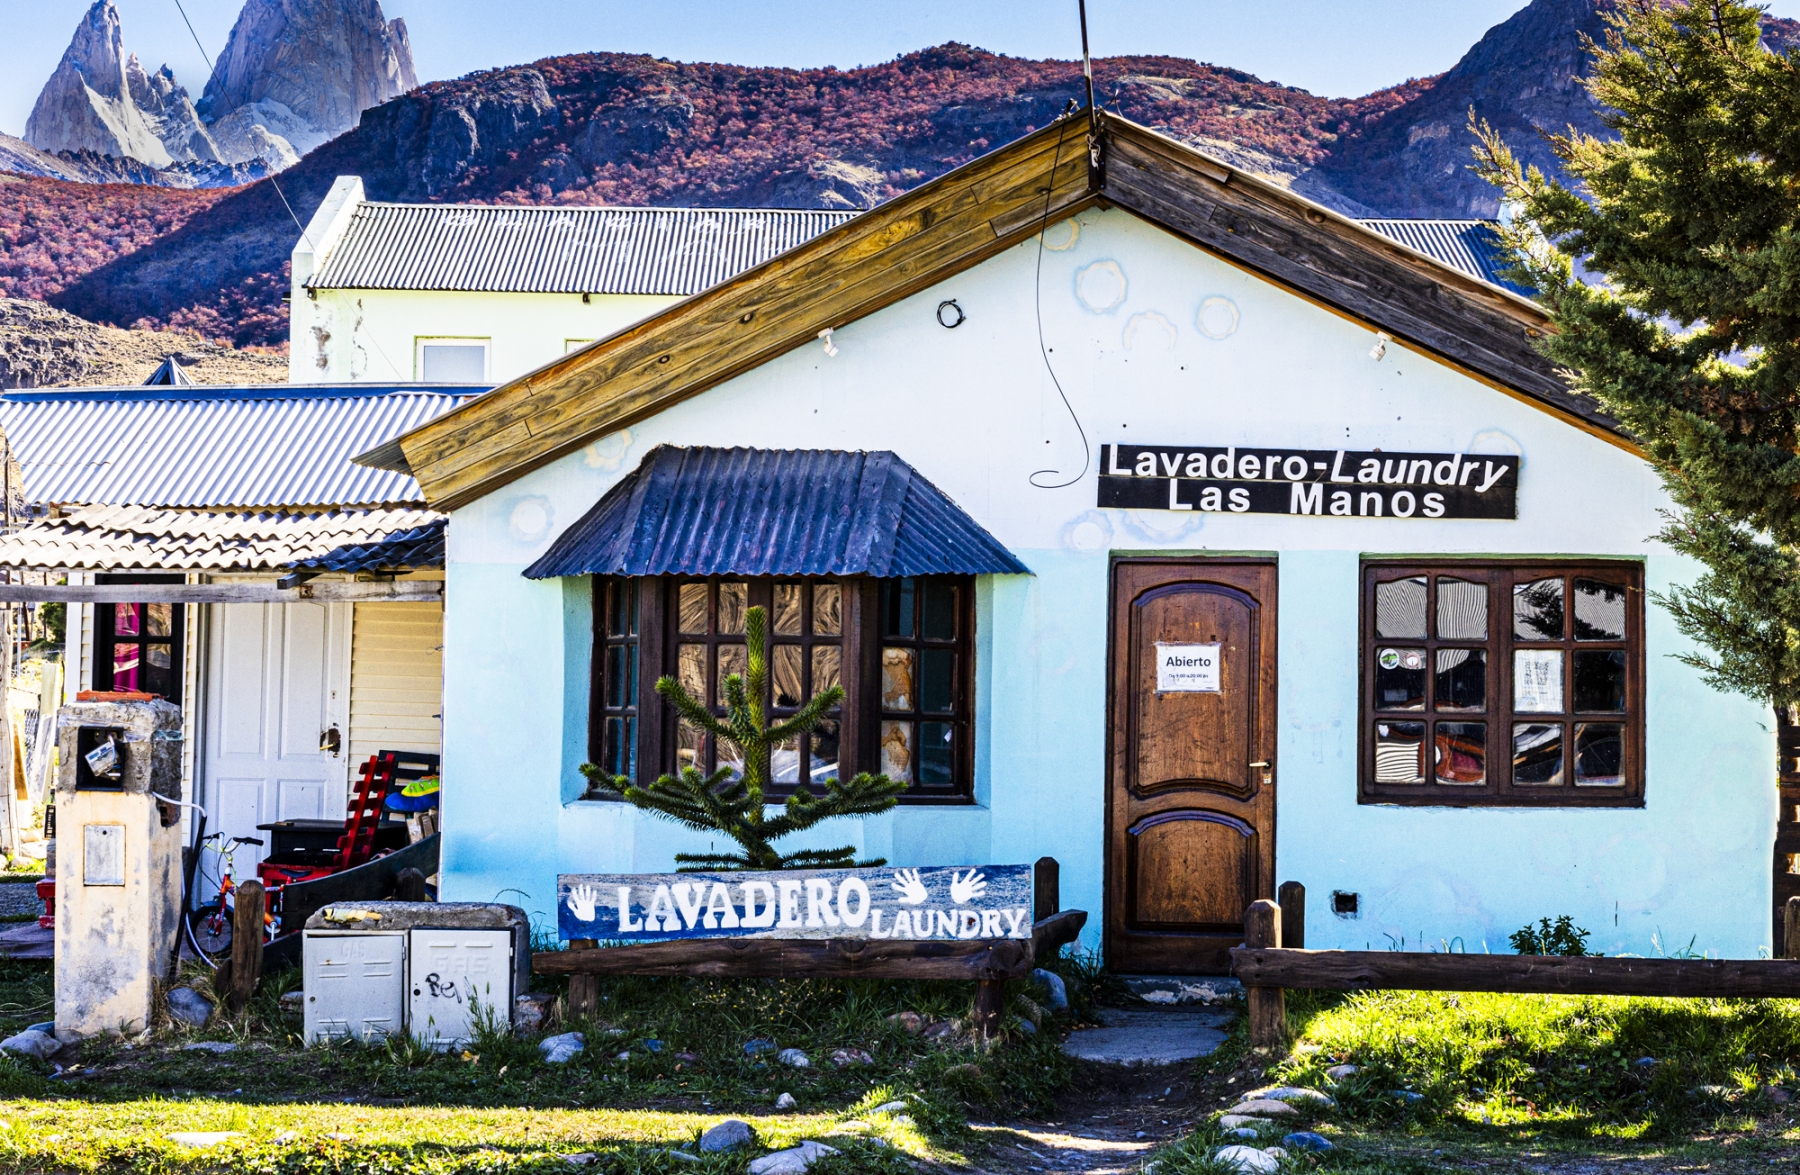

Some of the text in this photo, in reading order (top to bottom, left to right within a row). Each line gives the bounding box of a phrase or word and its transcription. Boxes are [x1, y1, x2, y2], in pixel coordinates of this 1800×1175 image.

[1108, 444, 1509, 493] Lavadero-Laundry
[1169, 478, 1446, 518] Las Manos
[1166, 656, 1211, 667] Abierto
[617, 876, 1027, 939] LAVADERO LAUNDRY
[433, 954, 489, 974] GAS
